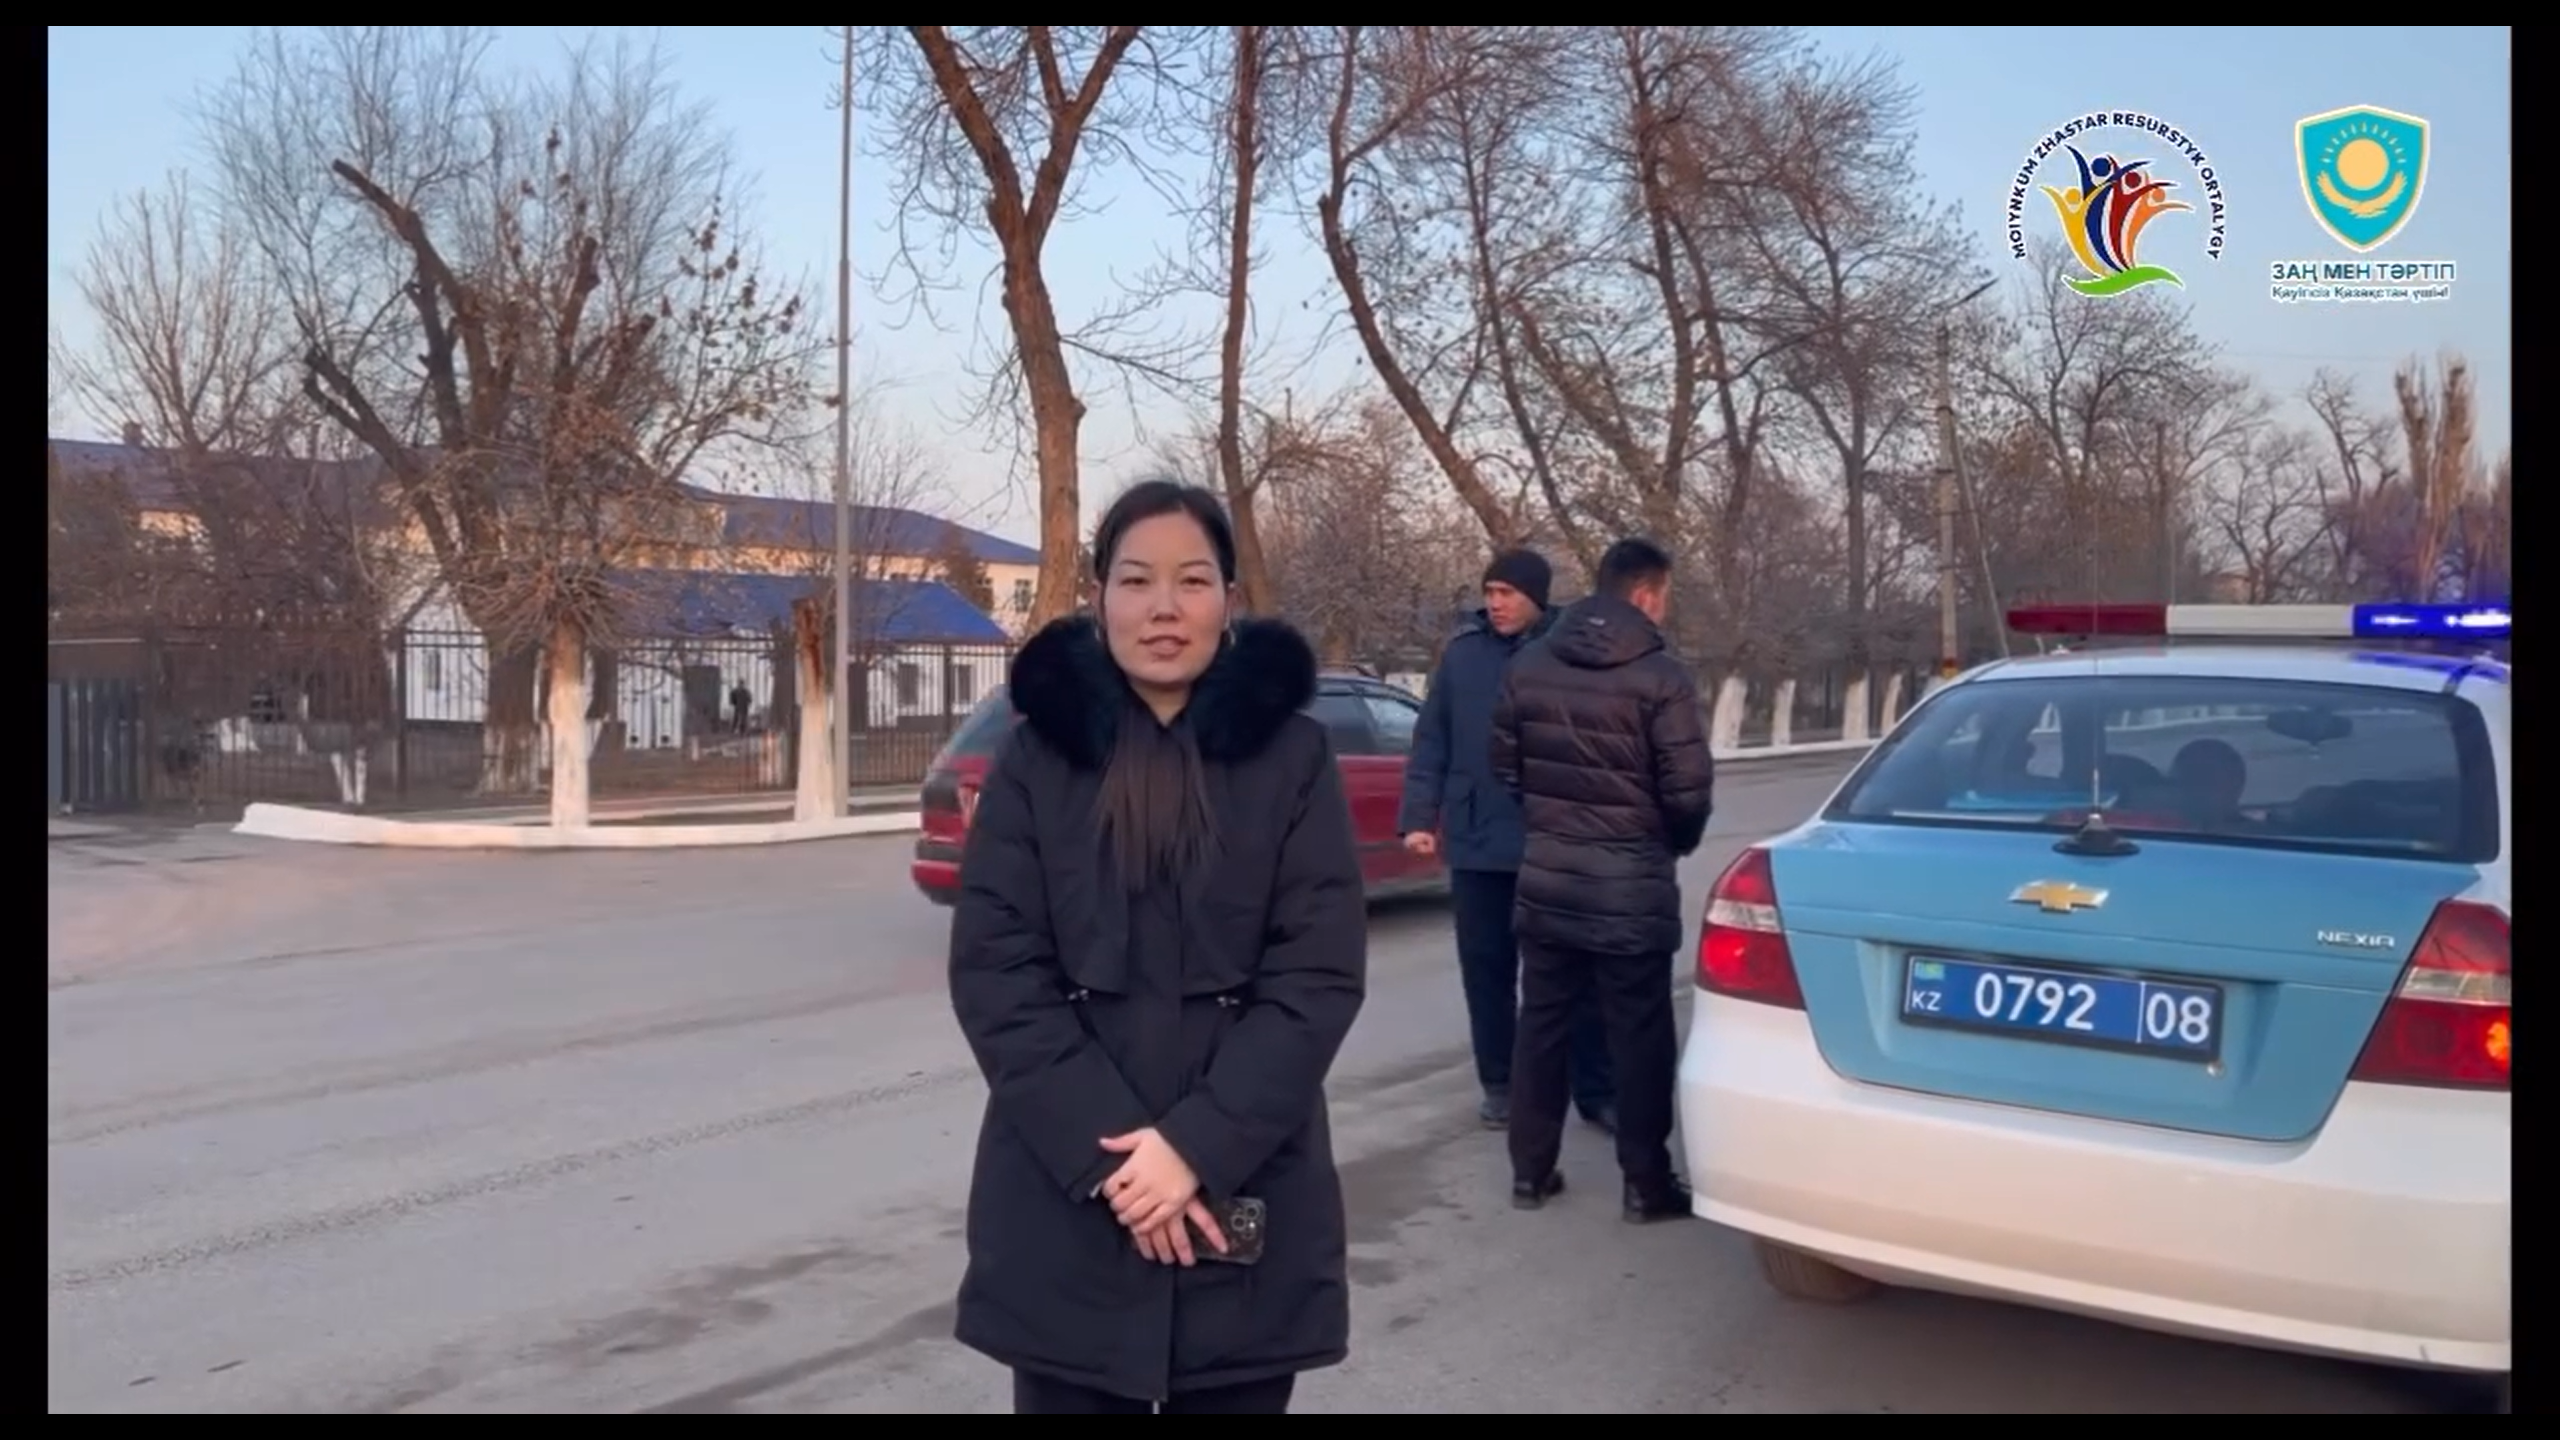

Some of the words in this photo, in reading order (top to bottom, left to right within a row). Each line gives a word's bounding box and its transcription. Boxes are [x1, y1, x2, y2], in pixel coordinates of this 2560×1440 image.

[2317, 930, 2395, 948] NEXIA
[1911, 990, 1942, 1012] KZ
[1974, 972, 2097, 1031] 0792
[2145, 992, 2212, 1044] 08
